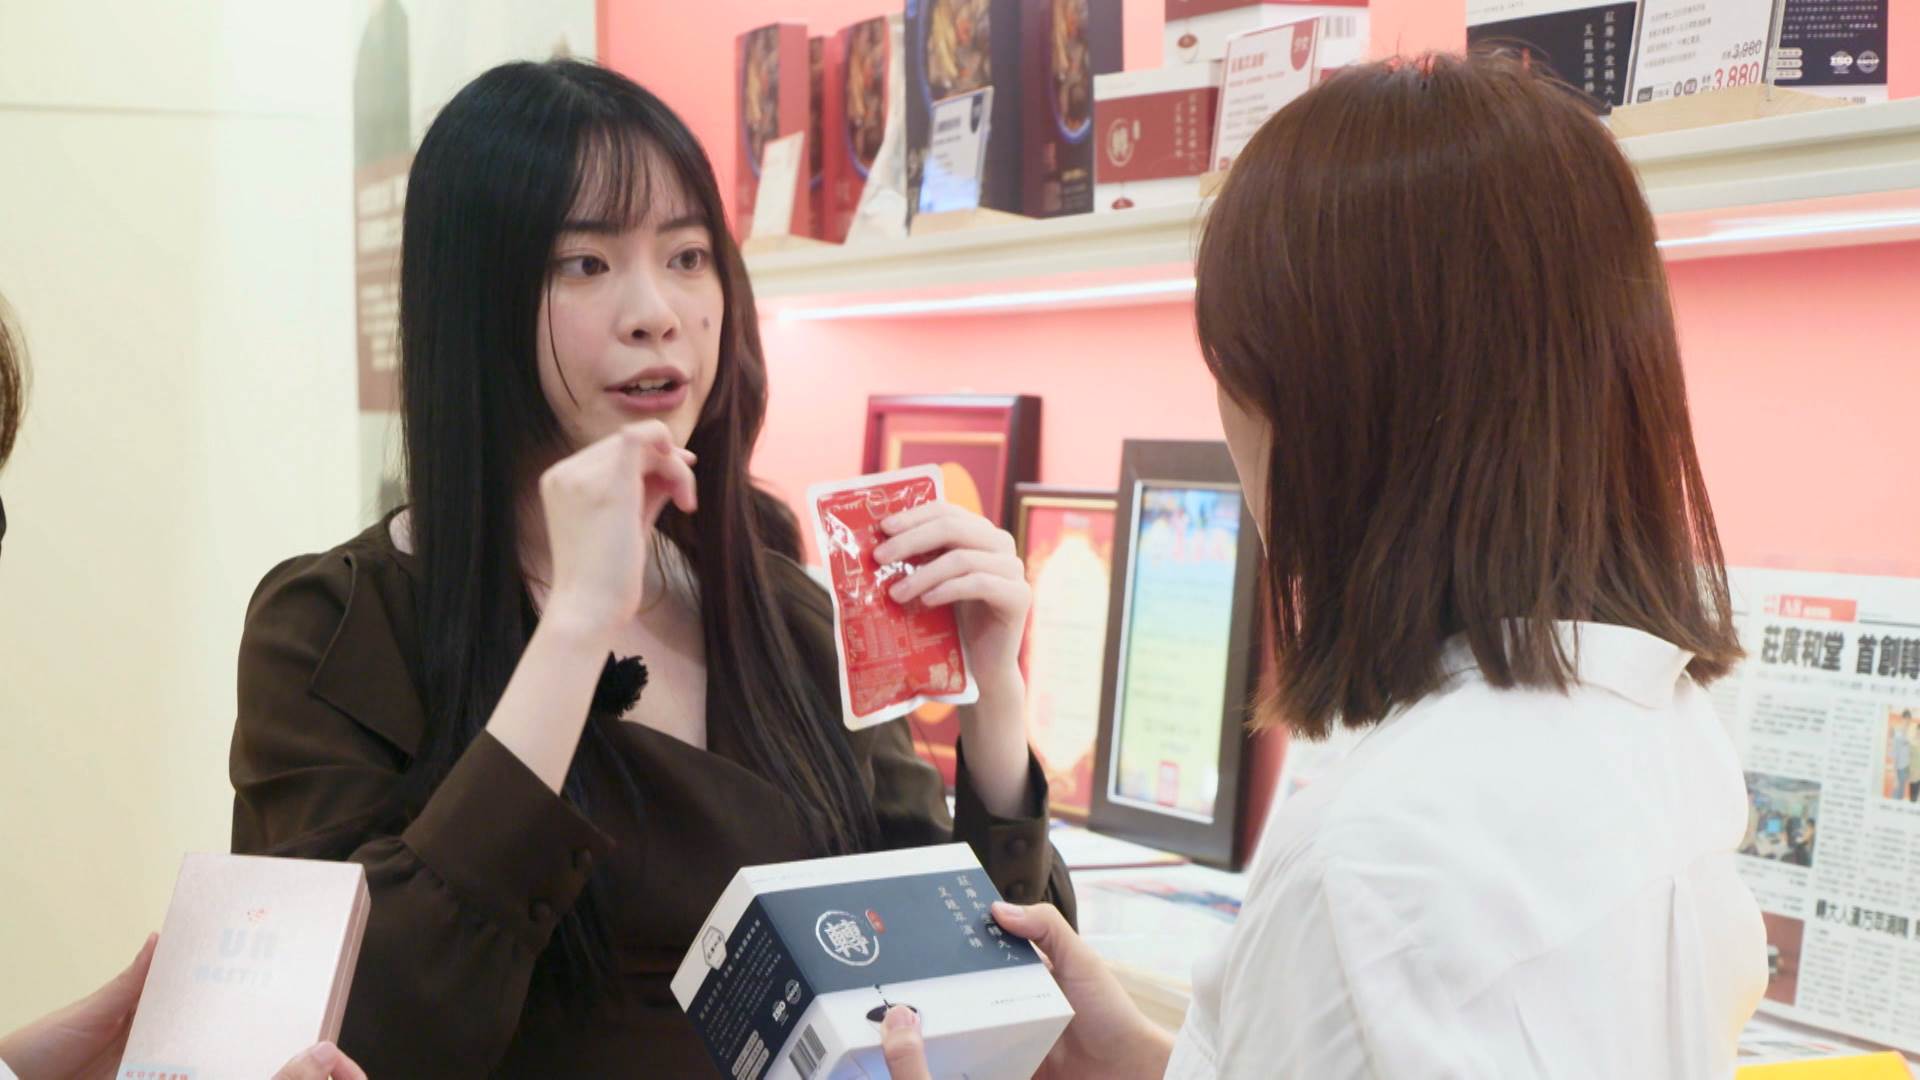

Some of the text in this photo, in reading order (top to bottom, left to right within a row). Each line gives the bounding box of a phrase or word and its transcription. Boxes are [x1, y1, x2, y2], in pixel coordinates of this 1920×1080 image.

[1830, 56, 1853, 67] ISO
[1761, 624, 1920, 680] 莊廣和堂 首創轉
[824, 919, 869, 957] 轉
[772, 1000, 786, 1022] ISO
